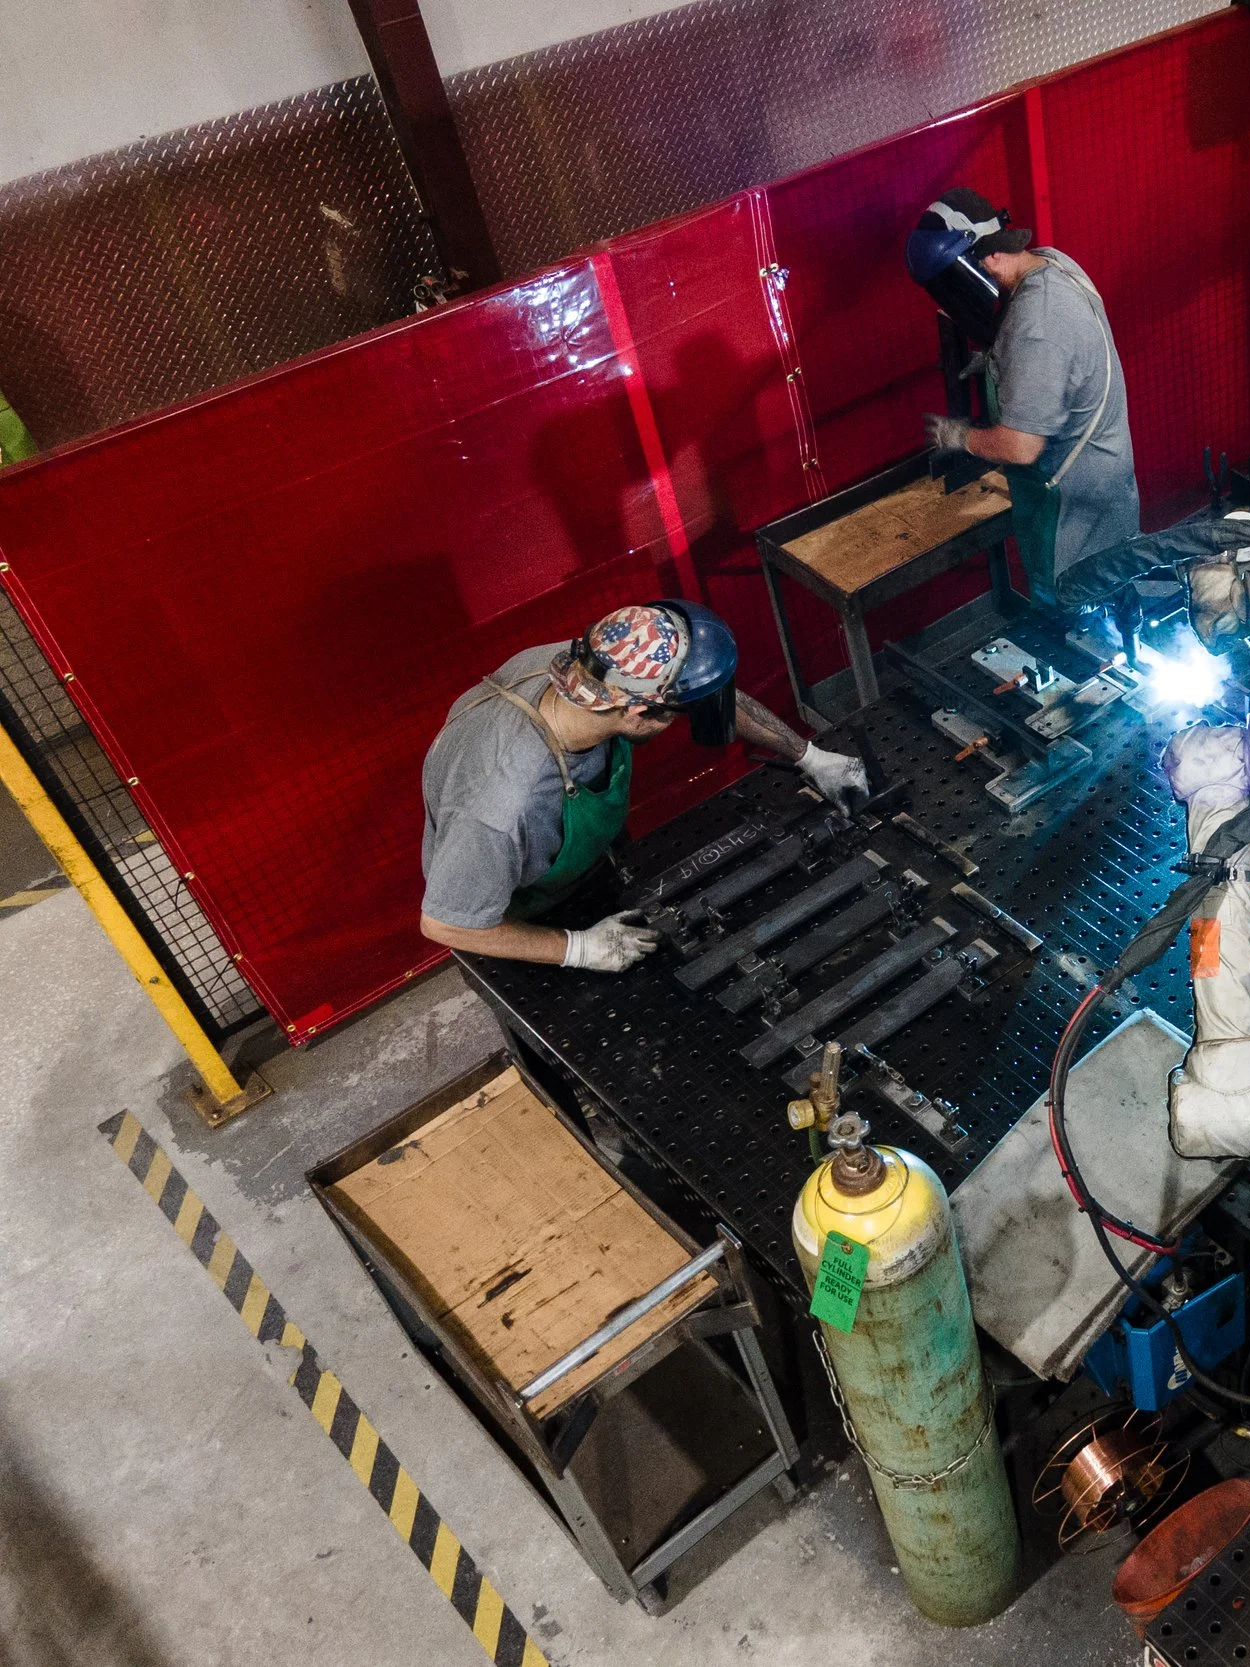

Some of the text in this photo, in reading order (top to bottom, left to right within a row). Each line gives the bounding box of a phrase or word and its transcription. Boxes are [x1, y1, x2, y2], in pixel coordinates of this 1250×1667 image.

[822, 1260, 861, 1287] CYLINDER
[834, 1257, 852, 1273] FULL
[820, 1282, 853, 1306] FOR USE
[825, 1276, 852, 1295] READY
